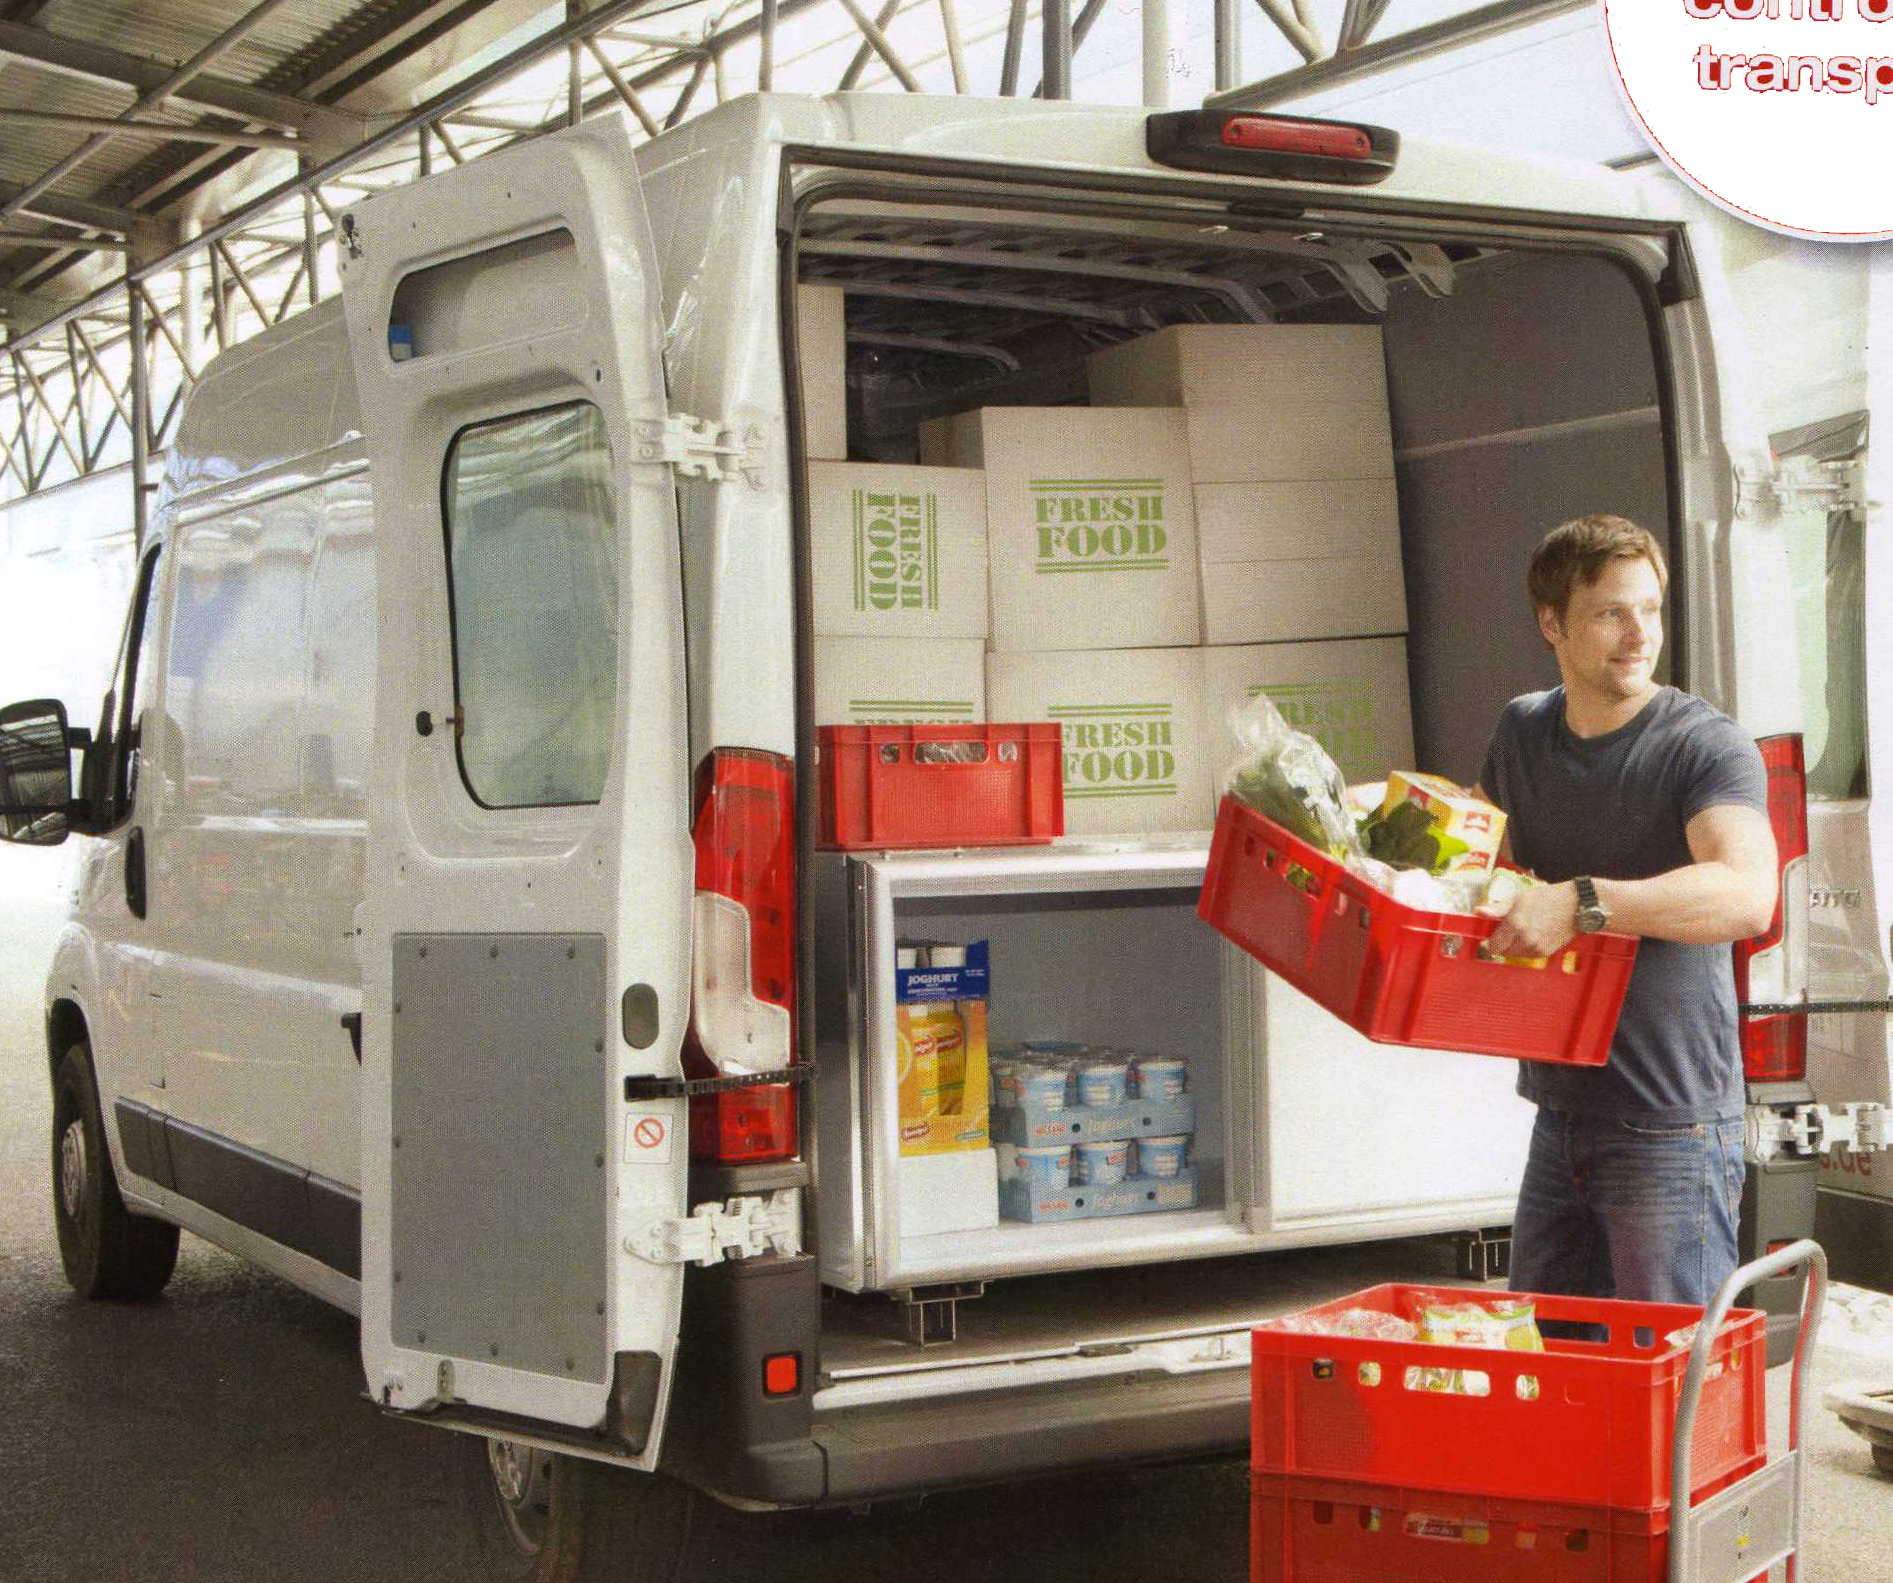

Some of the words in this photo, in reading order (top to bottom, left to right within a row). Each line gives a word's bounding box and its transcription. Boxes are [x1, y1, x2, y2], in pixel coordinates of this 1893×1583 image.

[1036, 495, 1163, 523] FRESH
[1036, 523, 1168, 558] FOOD
[867, 493, 898, 610] FOOD
[900, 493, 922, 608] FRESH
